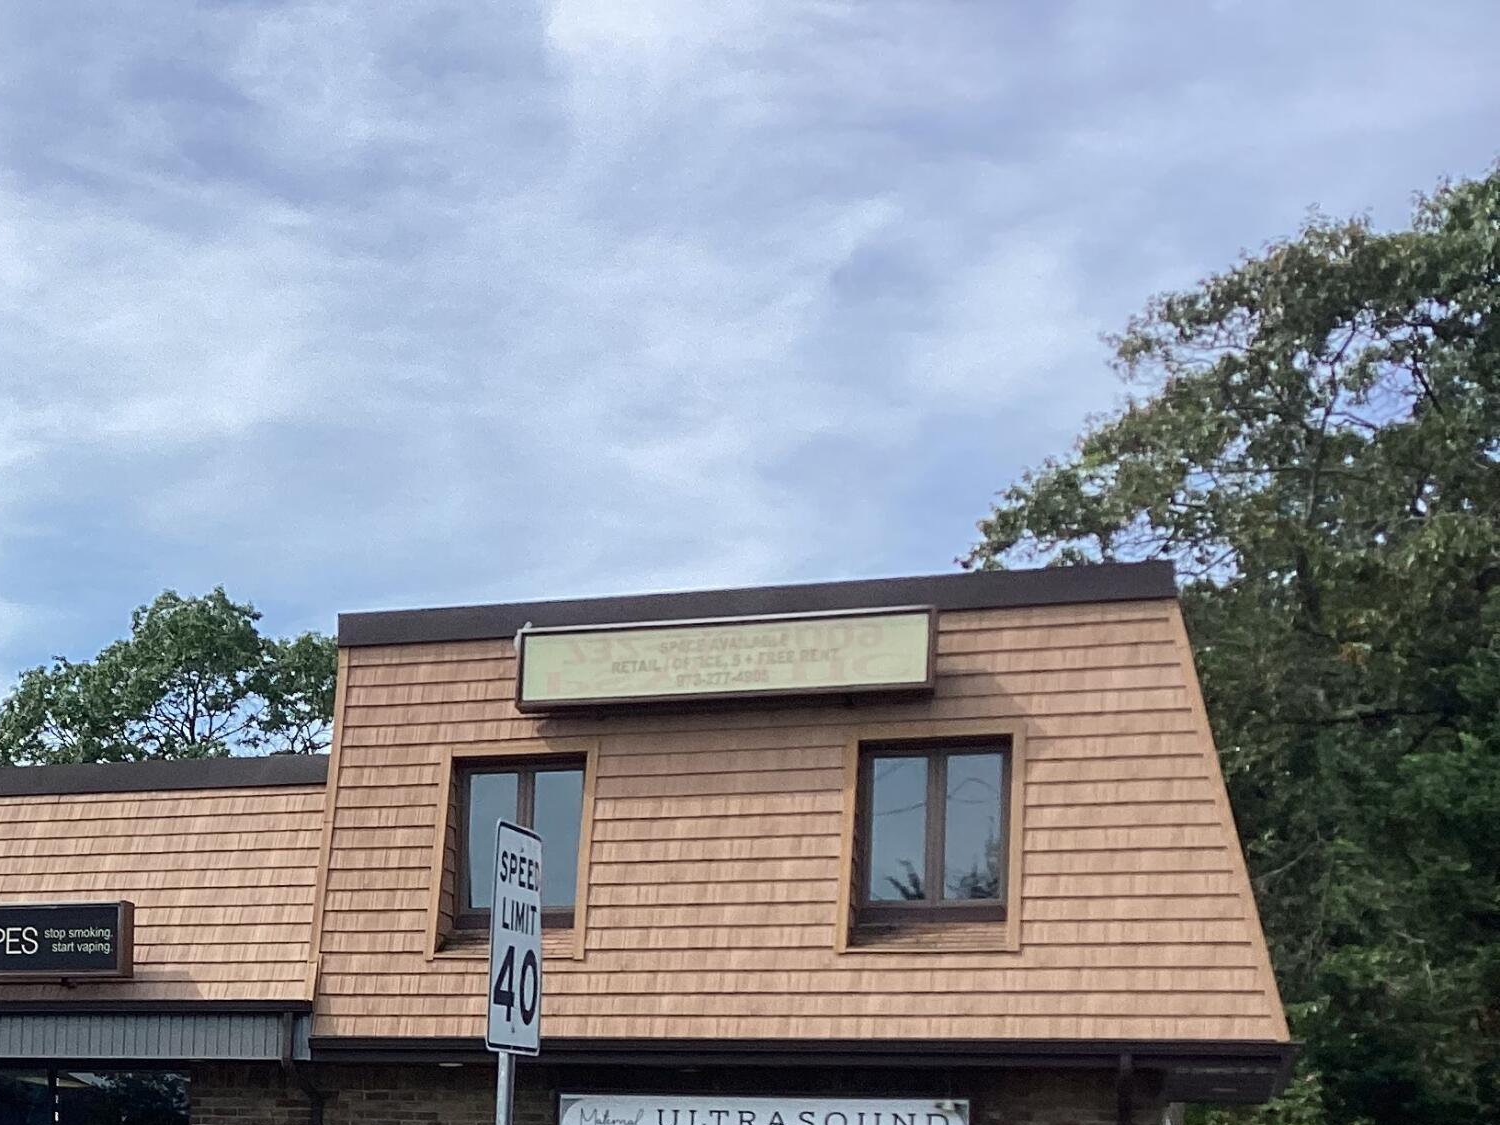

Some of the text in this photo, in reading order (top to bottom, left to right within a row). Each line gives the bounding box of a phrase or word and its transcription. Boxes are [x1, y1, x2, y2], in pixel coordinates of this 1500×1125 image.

[611, 658, 661, 675] RETAIL
[499, 850, 539, 892] SPEED
[501, 897, 538, 936] LIMIT
[44, 928, 66, 941] stop
[51, 941, 74, 953] start
[493, 945, 538, 1026] 40
